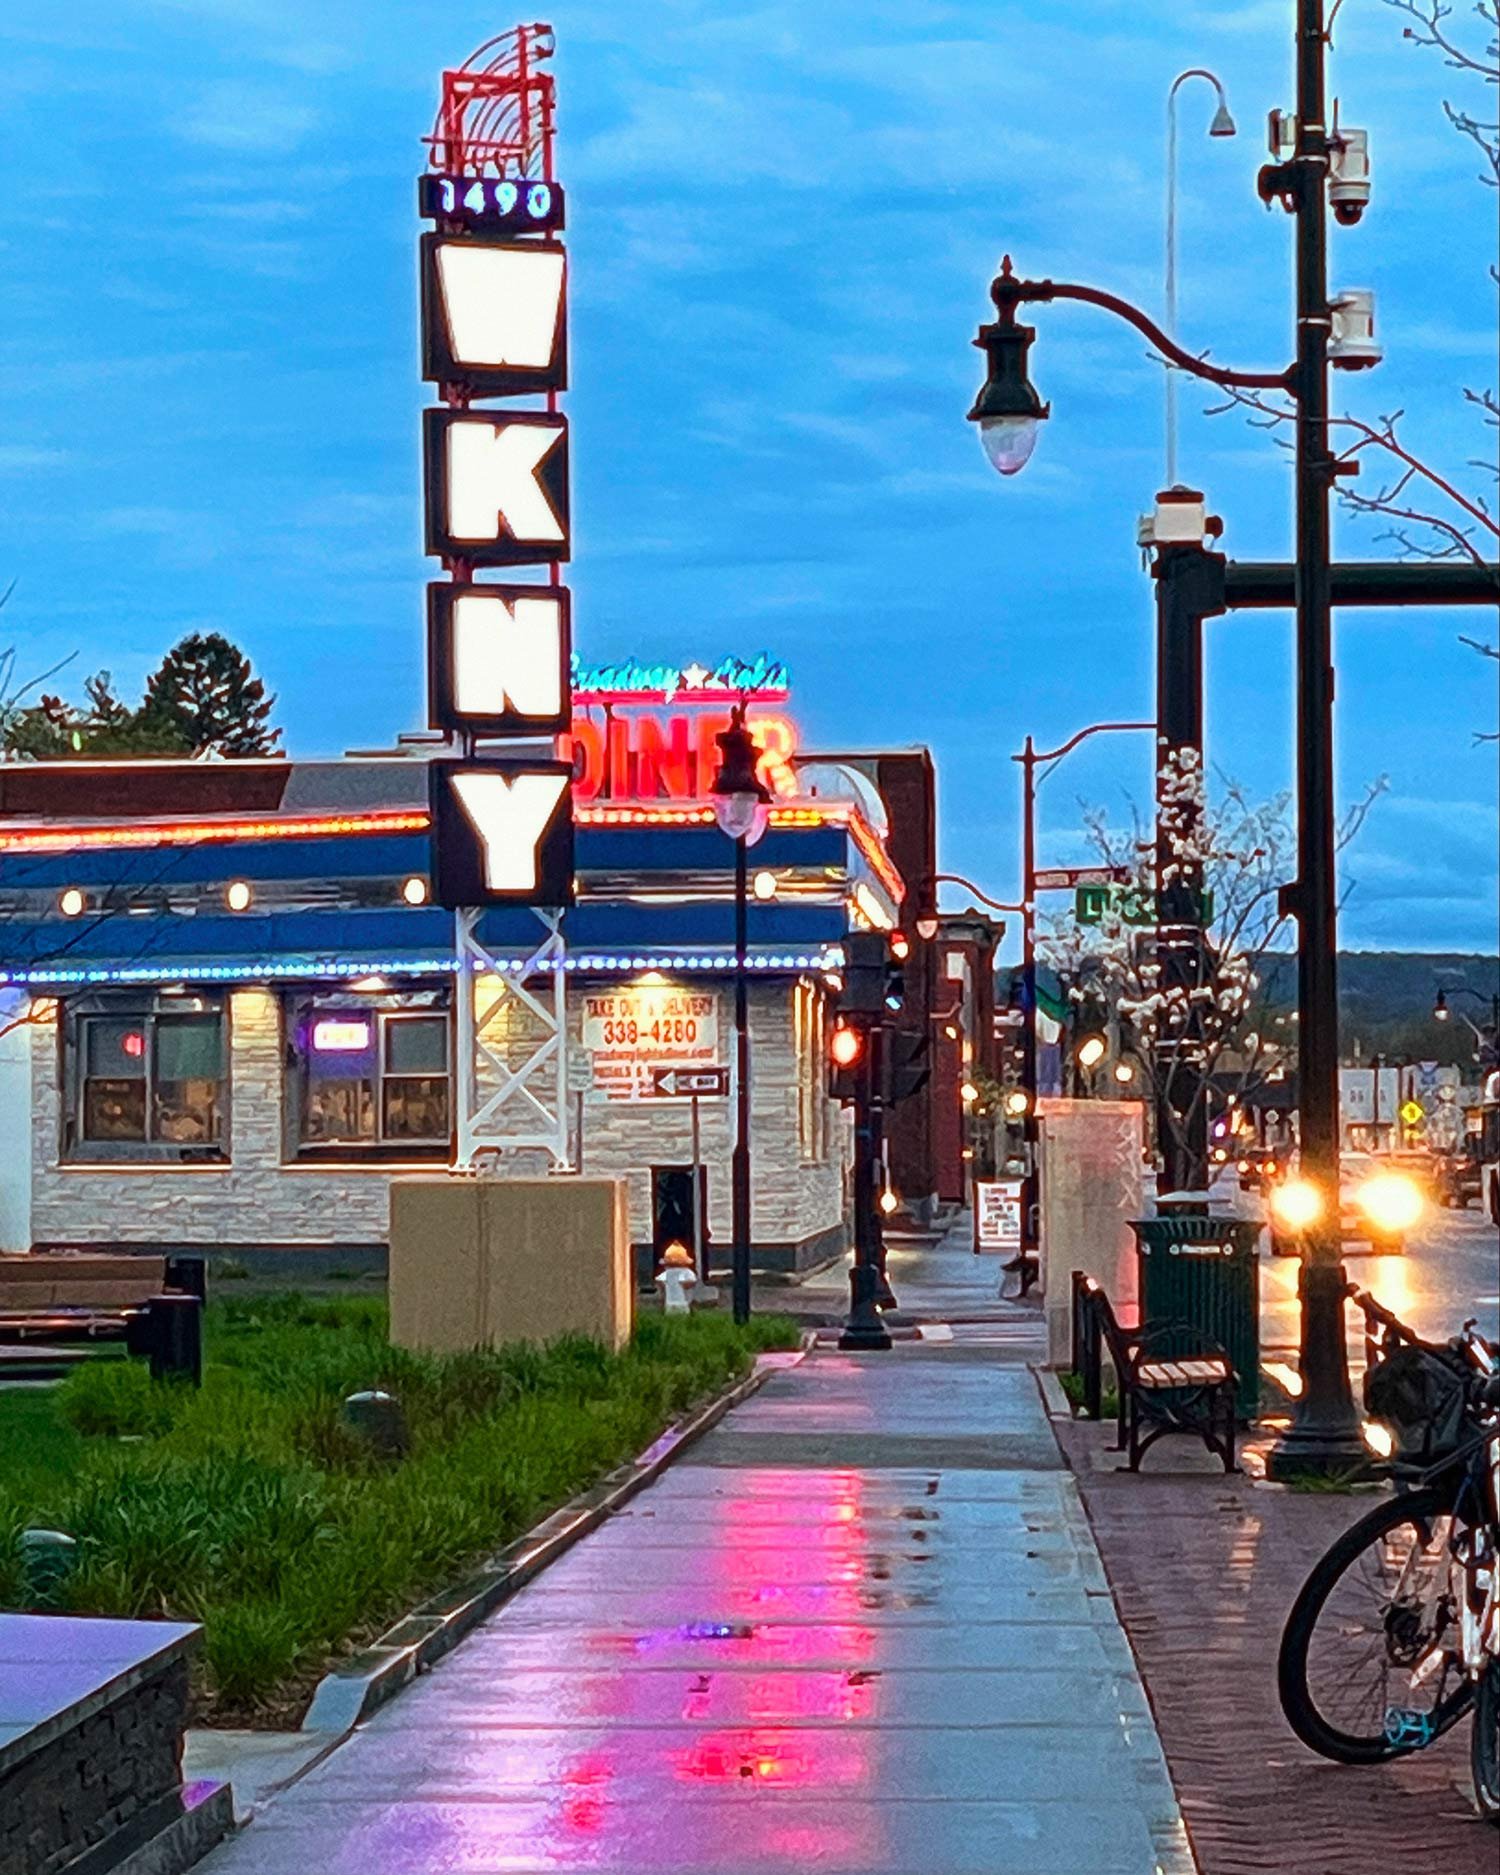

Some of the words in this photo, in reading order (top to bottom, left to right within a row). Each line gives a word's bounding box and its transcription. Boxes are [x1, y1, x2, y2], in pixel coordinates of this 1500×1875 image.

[438, 178, 552, 219] 1490
[558, 716, 801, 801] DINER
[603, 1019, 697, 1045] 338-4280
